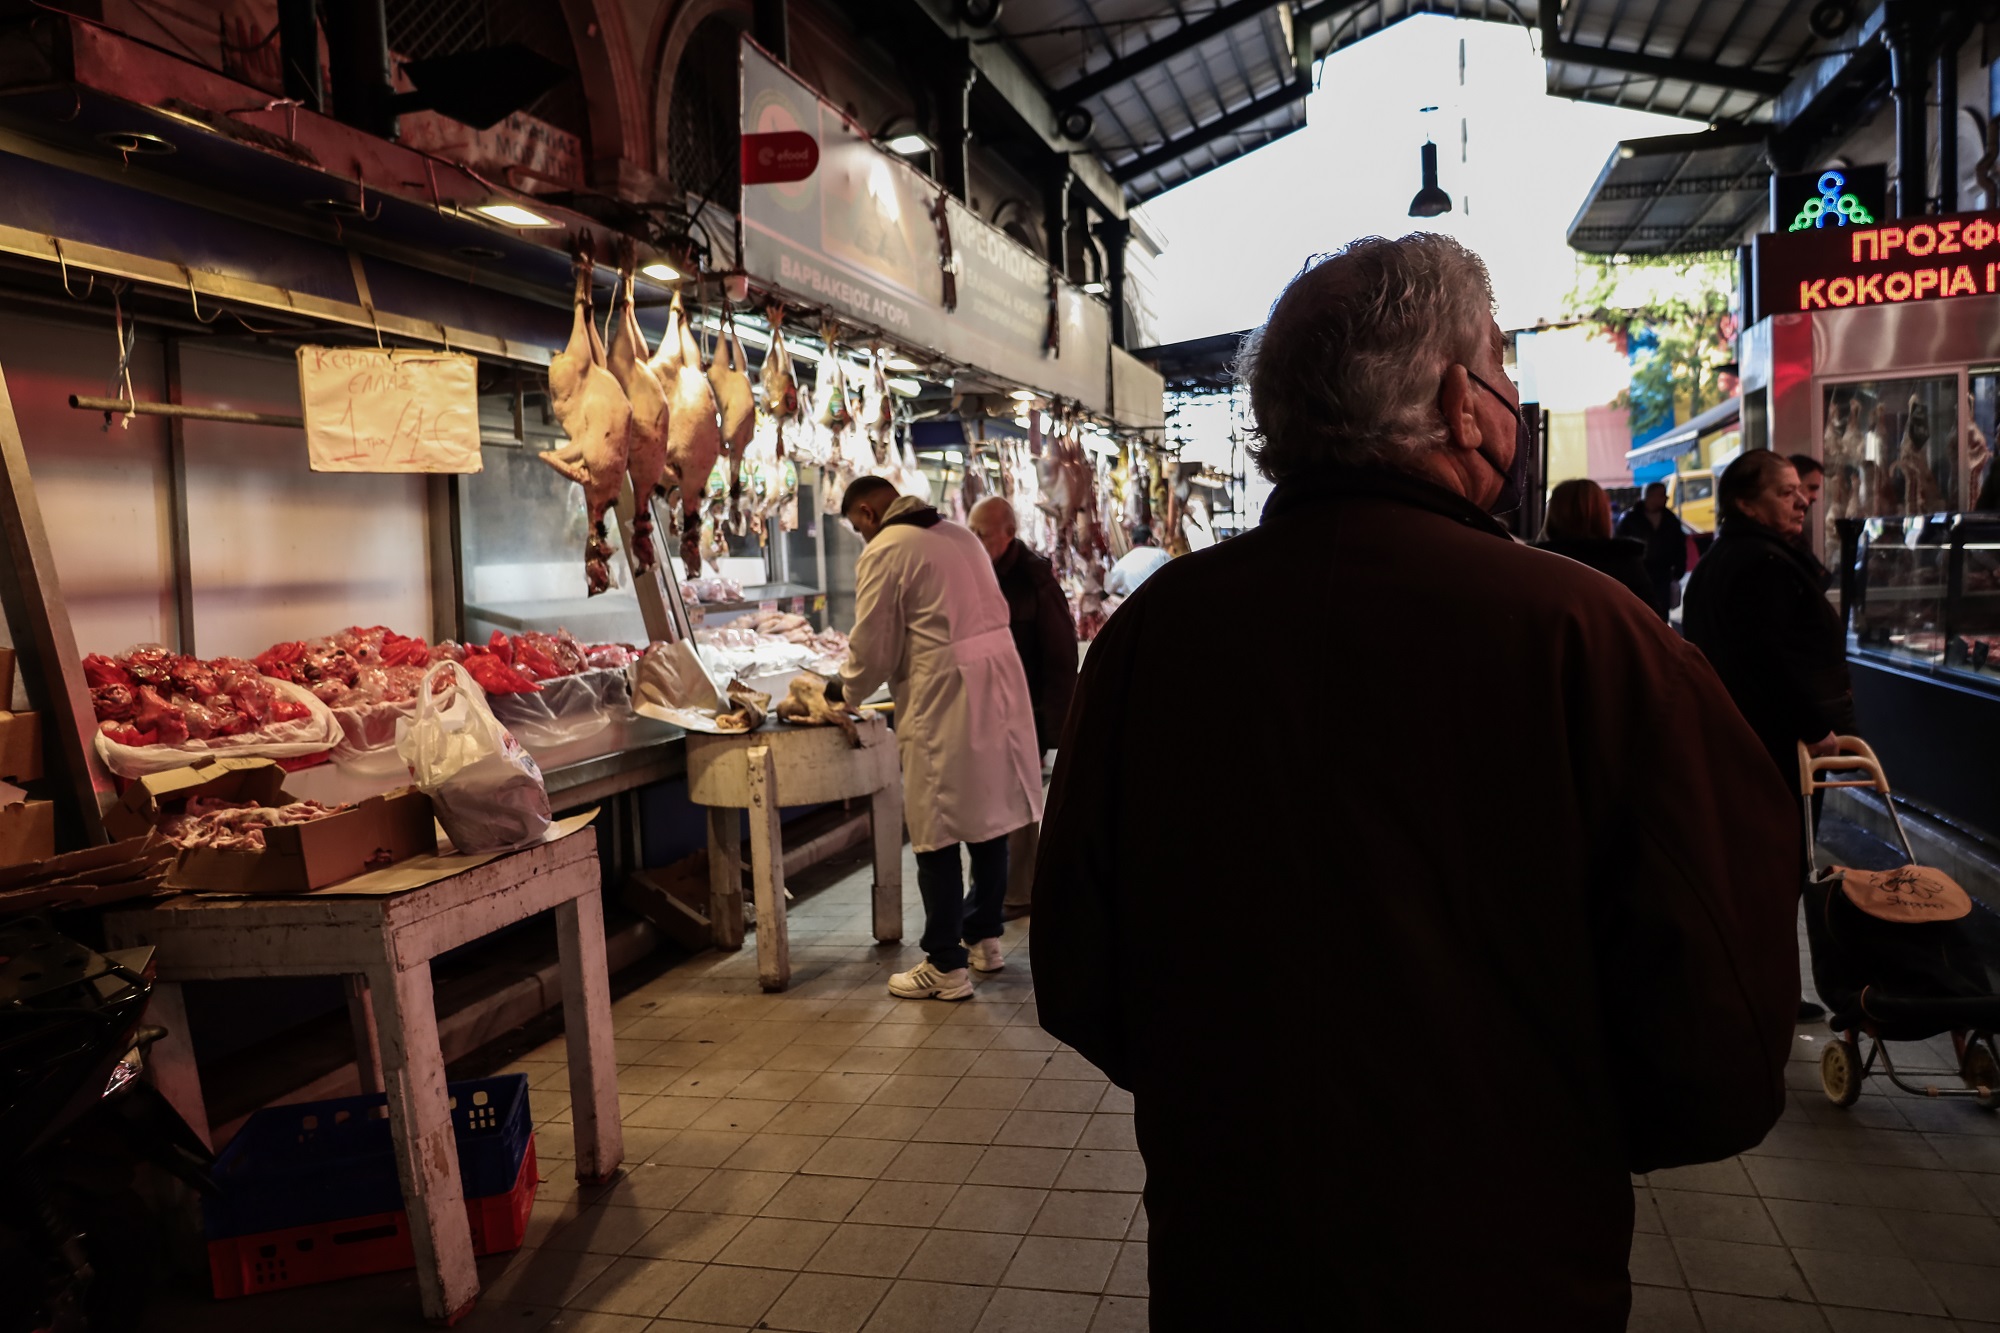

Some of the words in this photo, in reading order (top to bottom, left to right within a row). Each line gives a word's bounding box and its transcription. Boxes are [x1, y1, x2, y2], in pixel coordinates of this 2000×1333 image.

[776, 148, 809, 161] efood
[1852, 218, 2000, 263] ΠΡΟΣΦ
[780, 254, 871, 312] ΒΑΡΒΑΚΕΙΟΣ
[872, 297, 911, 329] ΑΓΟΡΑ
[1800, 264, 1977, 310] ΚΟΚΟΡΙΑ
[1985, 262, 2000, 293] Ι
